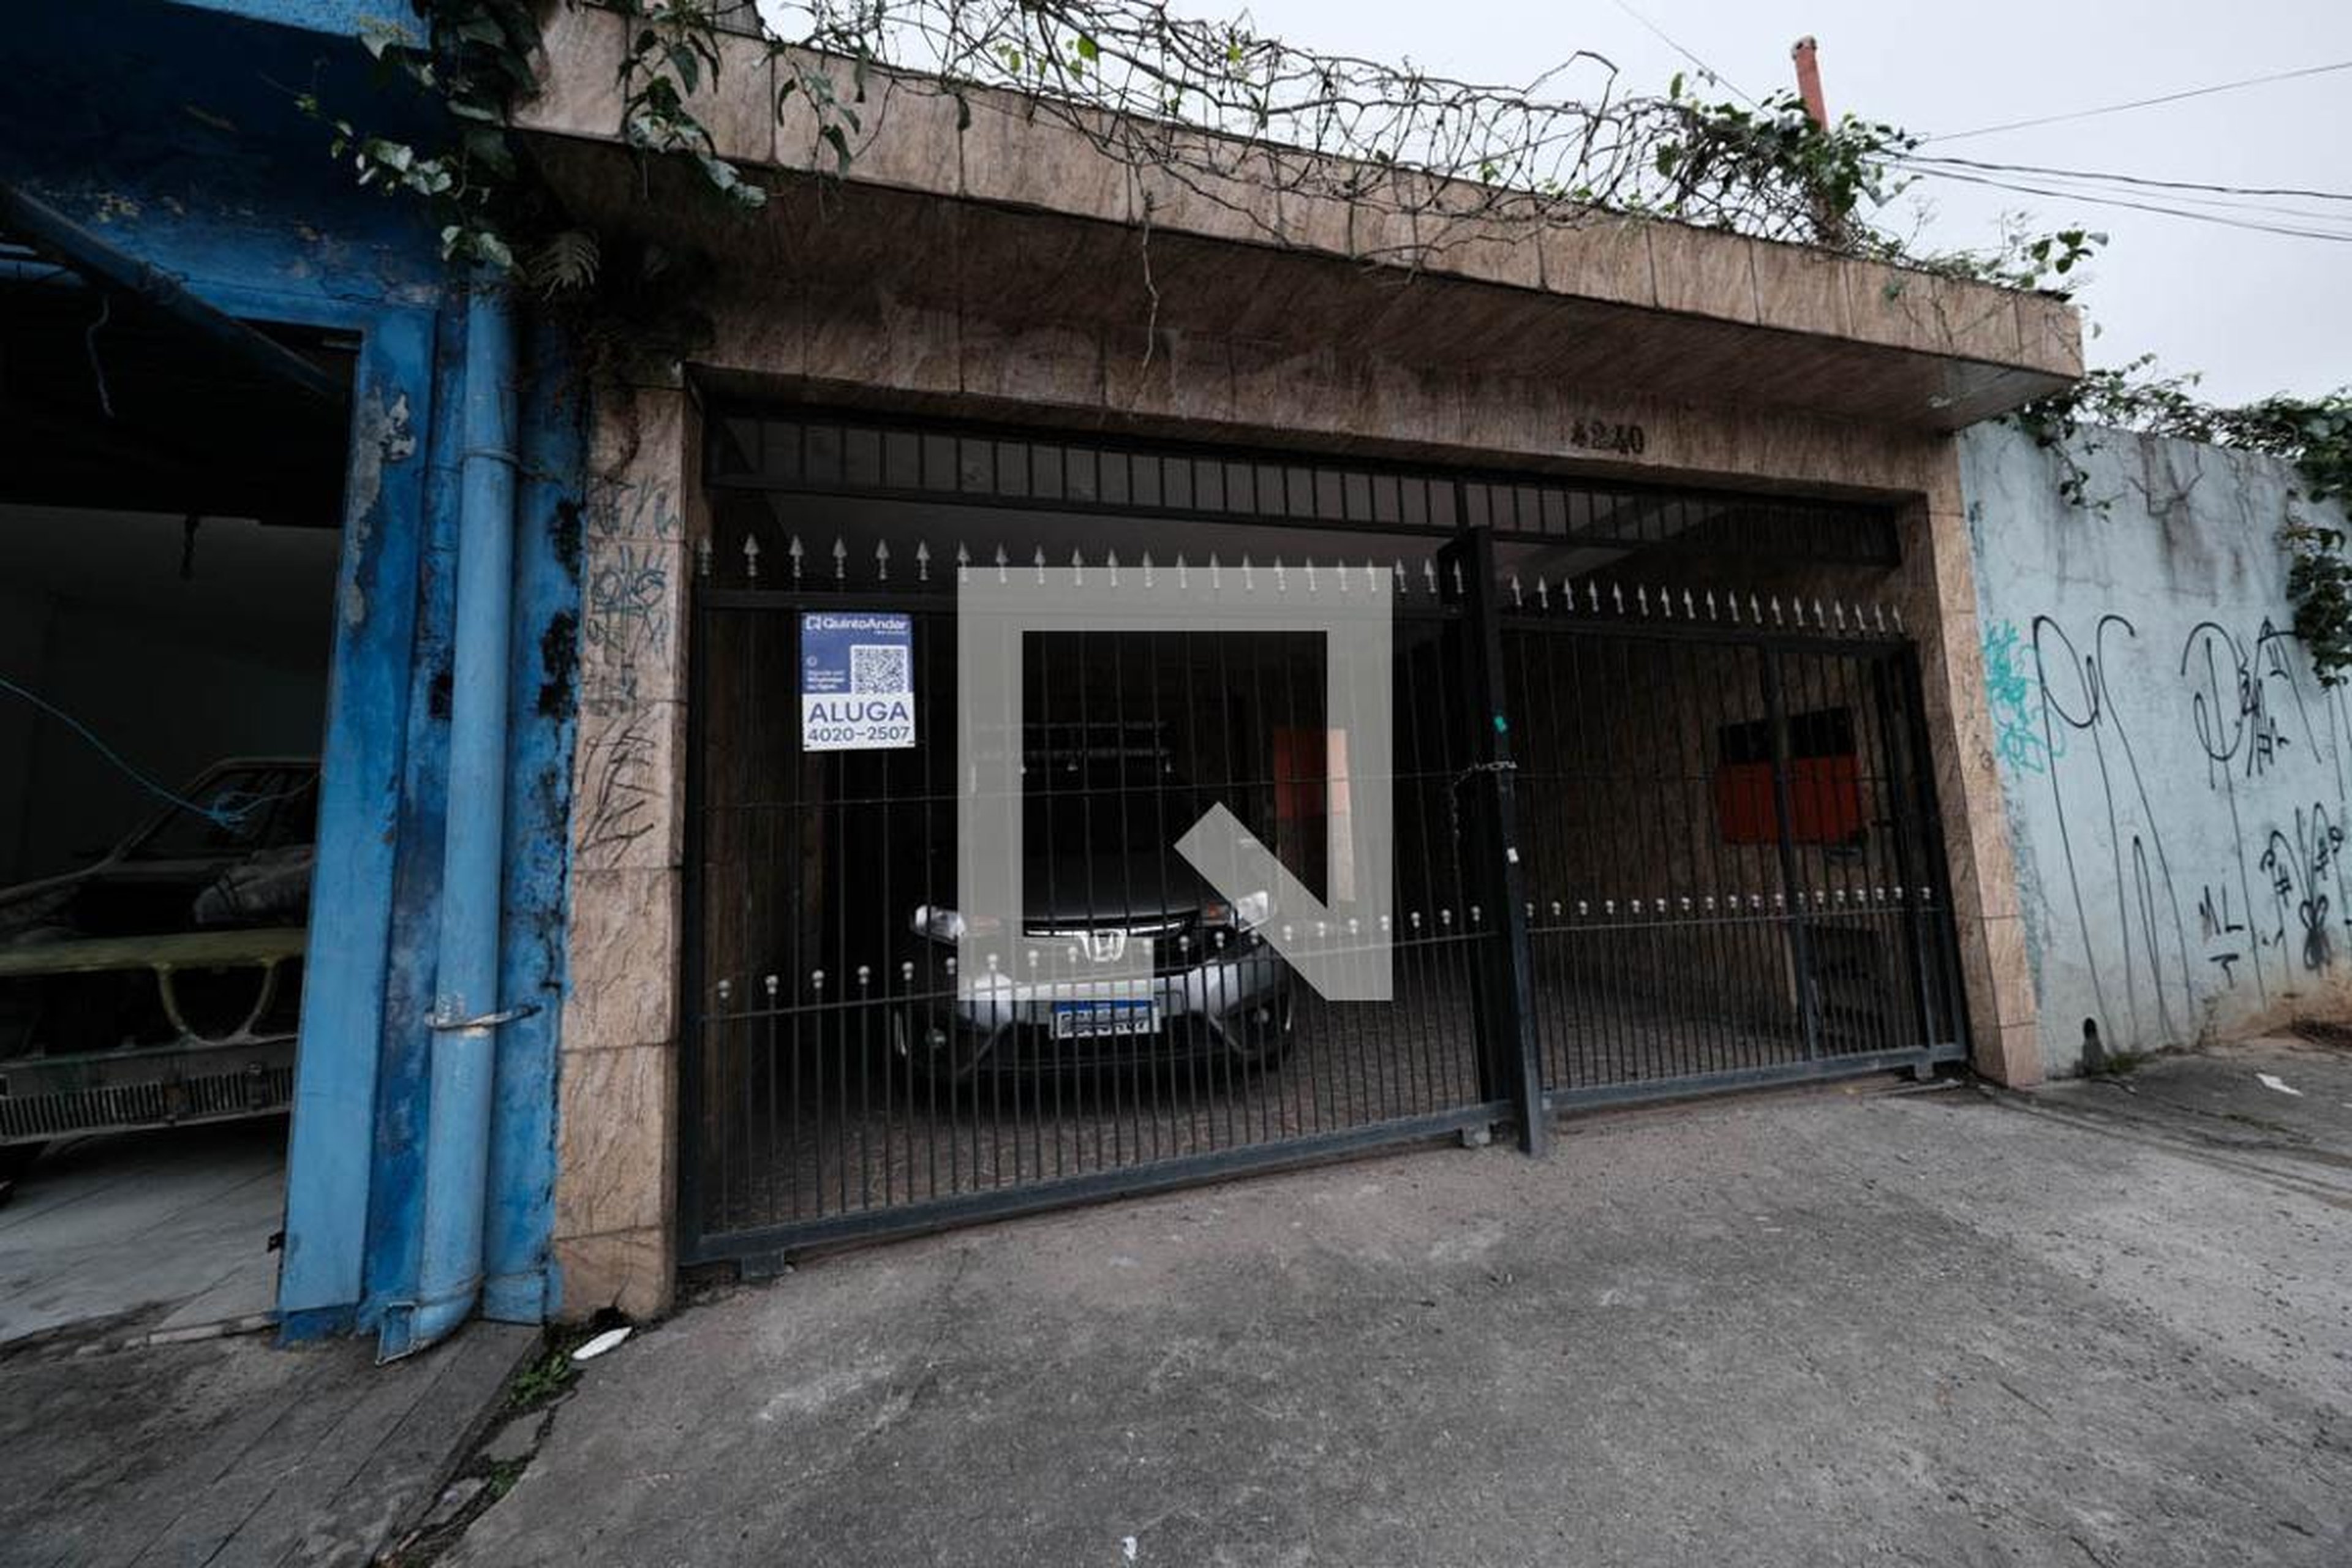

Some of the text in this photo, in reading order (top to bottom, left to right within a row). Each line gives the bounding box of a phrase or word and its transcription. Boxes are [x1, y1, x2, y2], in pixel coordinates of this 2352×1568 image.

[823, 617, 907, 630] QuintoAndar
[809, 701, 910, 723] ALUGA
[807, 726, 911, 742] 4020-2507
